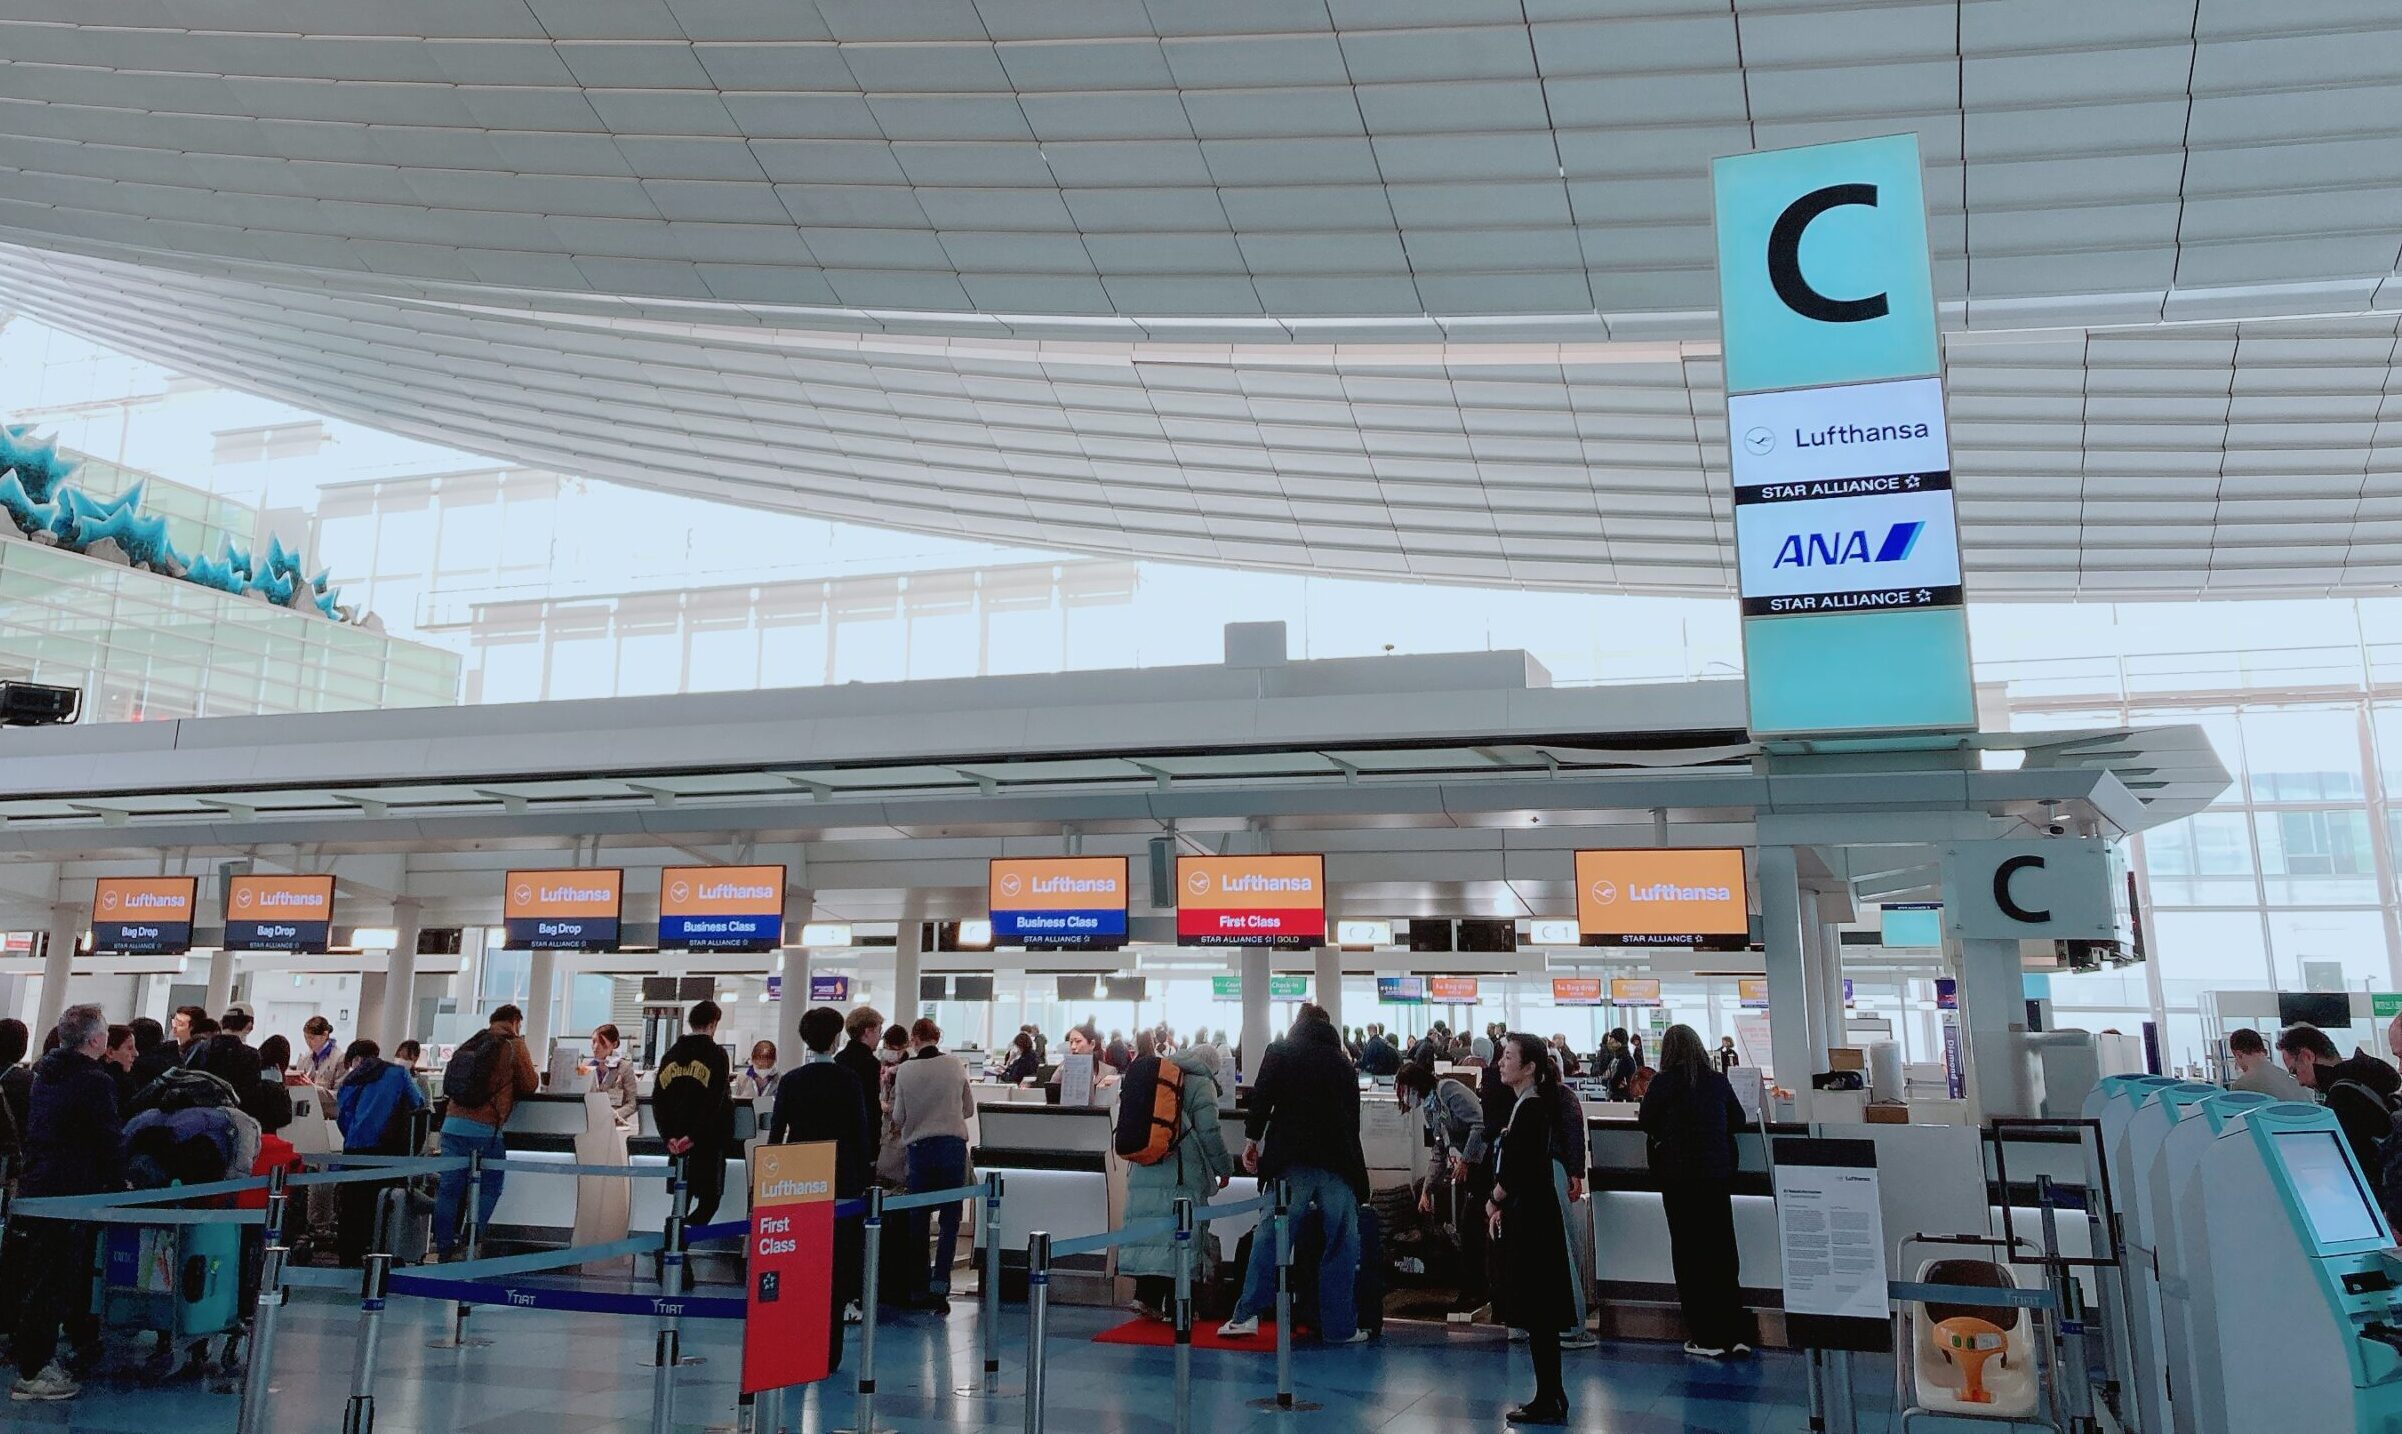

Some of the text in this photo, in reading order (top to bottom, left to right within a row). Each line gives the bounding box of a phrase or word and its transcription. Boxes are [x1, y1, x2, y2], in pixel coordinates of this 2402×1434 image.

[1768, 183, 1889, 322] C
[1796, 422, 1929, 448] Lufthansa
[1762, 477, 1900, 499] STAR ALLIANCE
[1773, 530, 1871, 569] ANA
[1770, 591, 1911, 611] STAR ALLIANCE
[1031, 876, 1116, 893] Lufthansa
[1221, 874, 1312, 892] Lufthansa
[1993, 855, 2051, 923] C
[259, 891, 323, 906] Lufthansa
[540, 886, 611, 902] Lufthansa
[698, 883, 774, 900] Lufthansa
[1628, 884, 1730, 901] Lufthansa
[125, 892, 185, 908] Lufthansa
[538, 923, 582, 936] Bag Drop
[683, 921, 756, 933] Business Class
[1016, 915, 1098, 928] Business Class
[1219, 915, 1281, 928] First Class
[121, 926, 159, 939] Bag Drop
[257, 925, 296, 938] Bag Drop
[1023, 935, 1082, 943] STAR ALLIANCE
[1200, 935, 1299, 943] STAR ALLIANCE GOLD
[1621, 934, 1693, 943] STAR ALLIANCE
[531, 940, 549, 948] STAR
[707, 938, 742, 946] ALLIANCE
[761, 1180, 828, 1198] Lufthansa
[760, 1216, 790, 1234] First
[759, 1238, 796, 1255] Class
